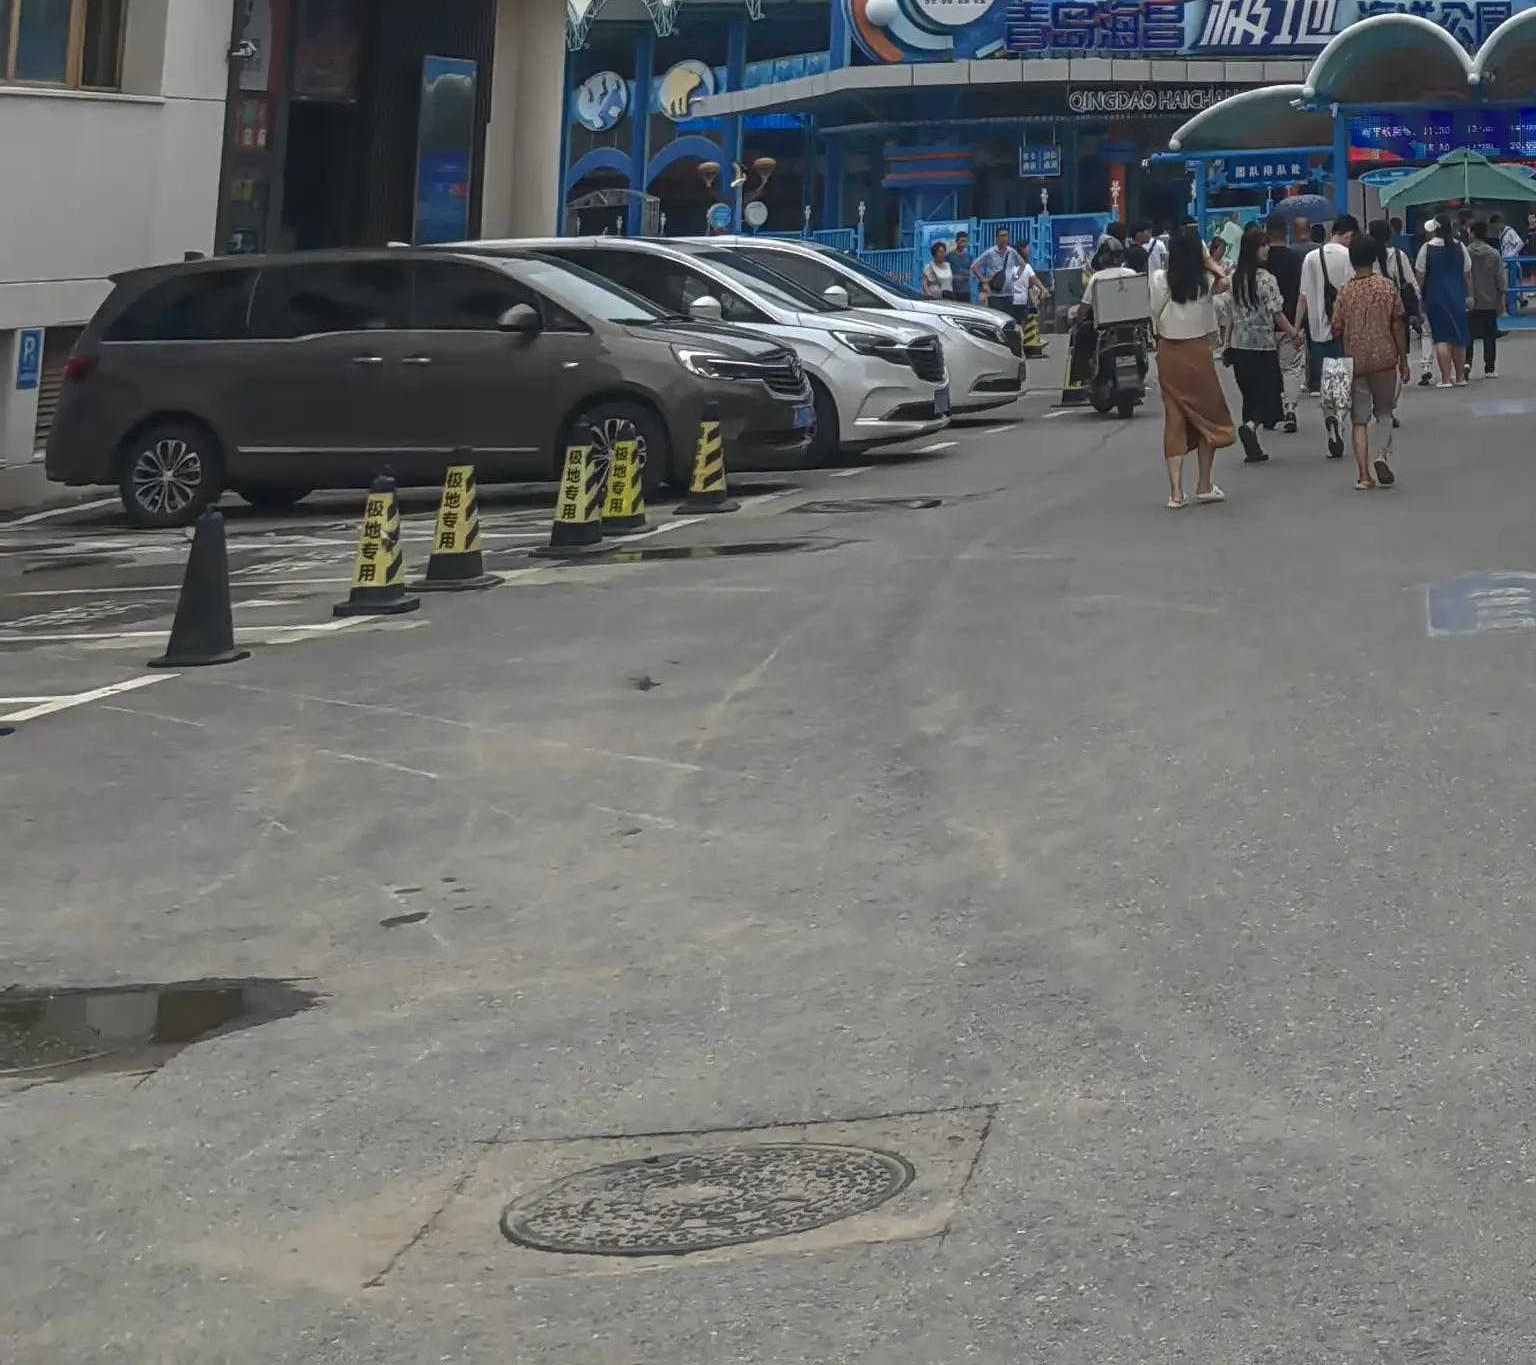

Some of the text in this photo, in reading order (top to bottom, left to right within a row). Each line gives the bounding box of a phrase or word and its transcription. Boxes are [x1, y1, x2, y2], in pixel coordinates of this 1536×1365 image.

[1069, 90, 1157, 112] QINGDAO
[439, 471, 463, 549] 极地专用
[561, 449, 583, 520] 极地专用
[609, 446, 629, 514] 极地专用
[357, 500, 385, 582] 极地专用
